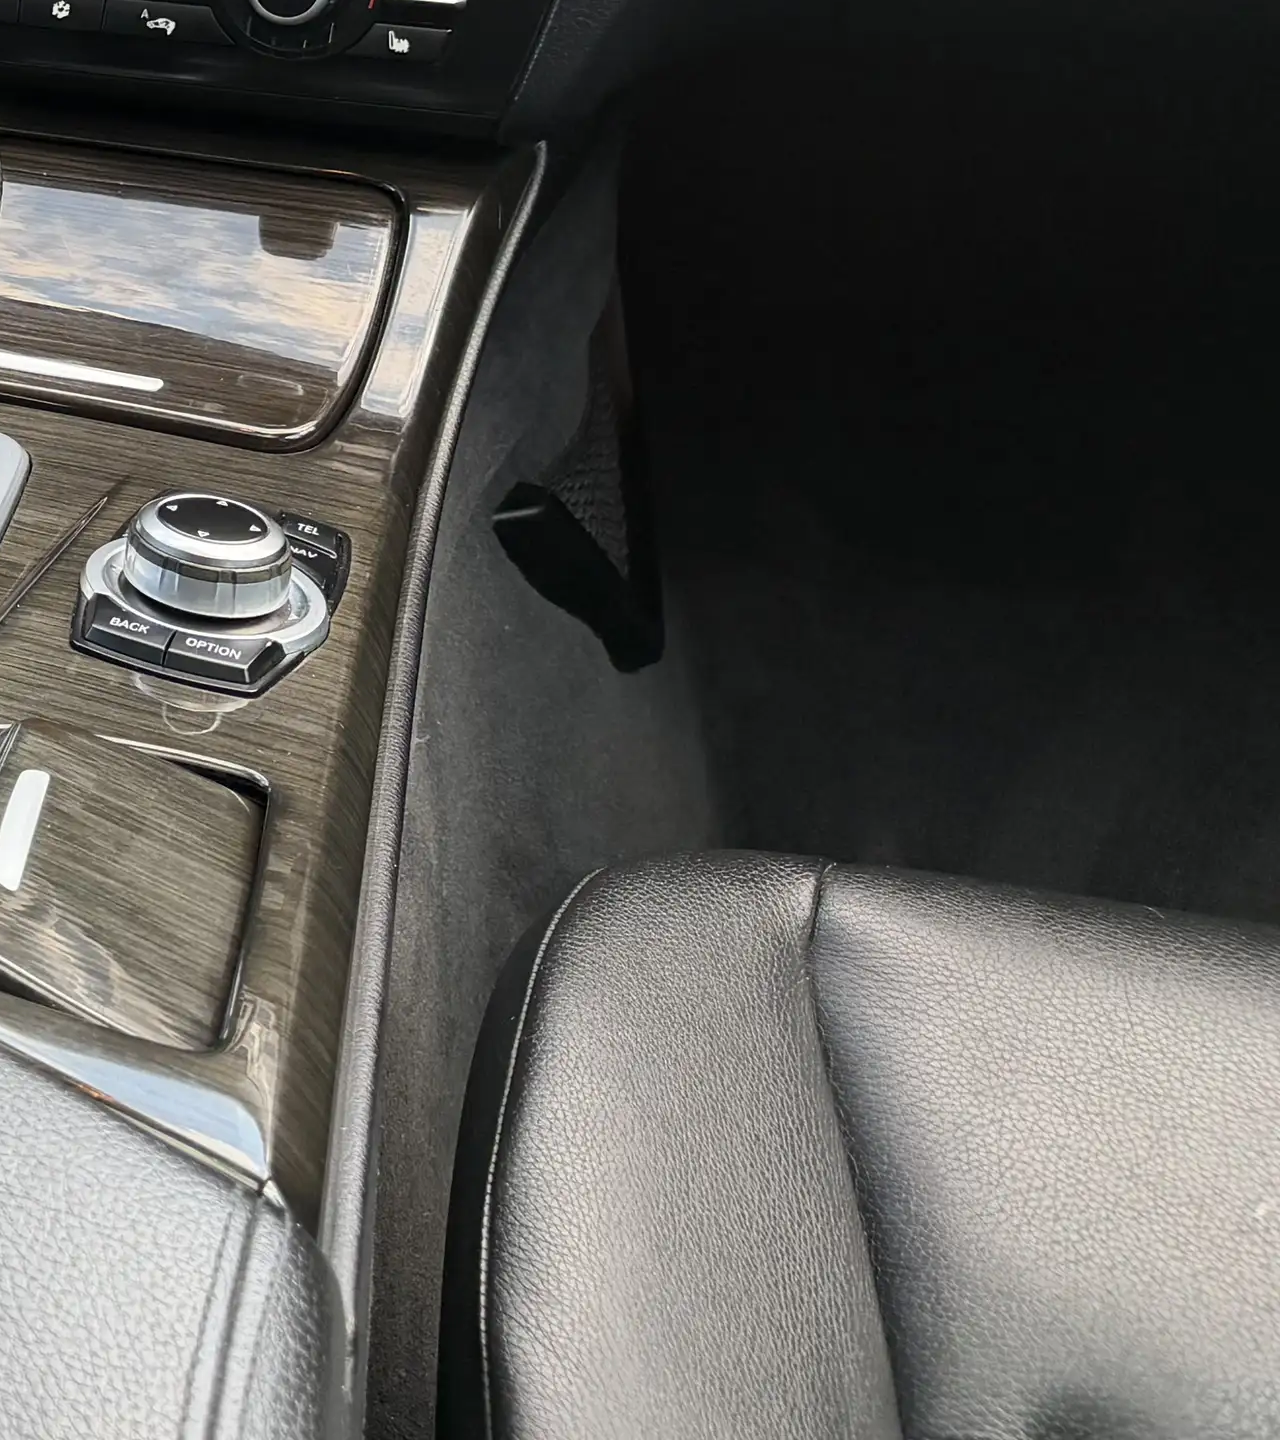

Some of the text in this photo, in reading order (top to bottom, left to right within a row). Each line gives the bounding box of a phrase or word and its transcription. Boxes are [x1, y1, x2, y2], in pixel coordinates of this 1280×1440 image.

[296, 522, 320, 537] TEL
[290, 545, 318, 559] NAV
[109, 616, 150, 635] BACK
[185, 637, 242, 660] OPTION
